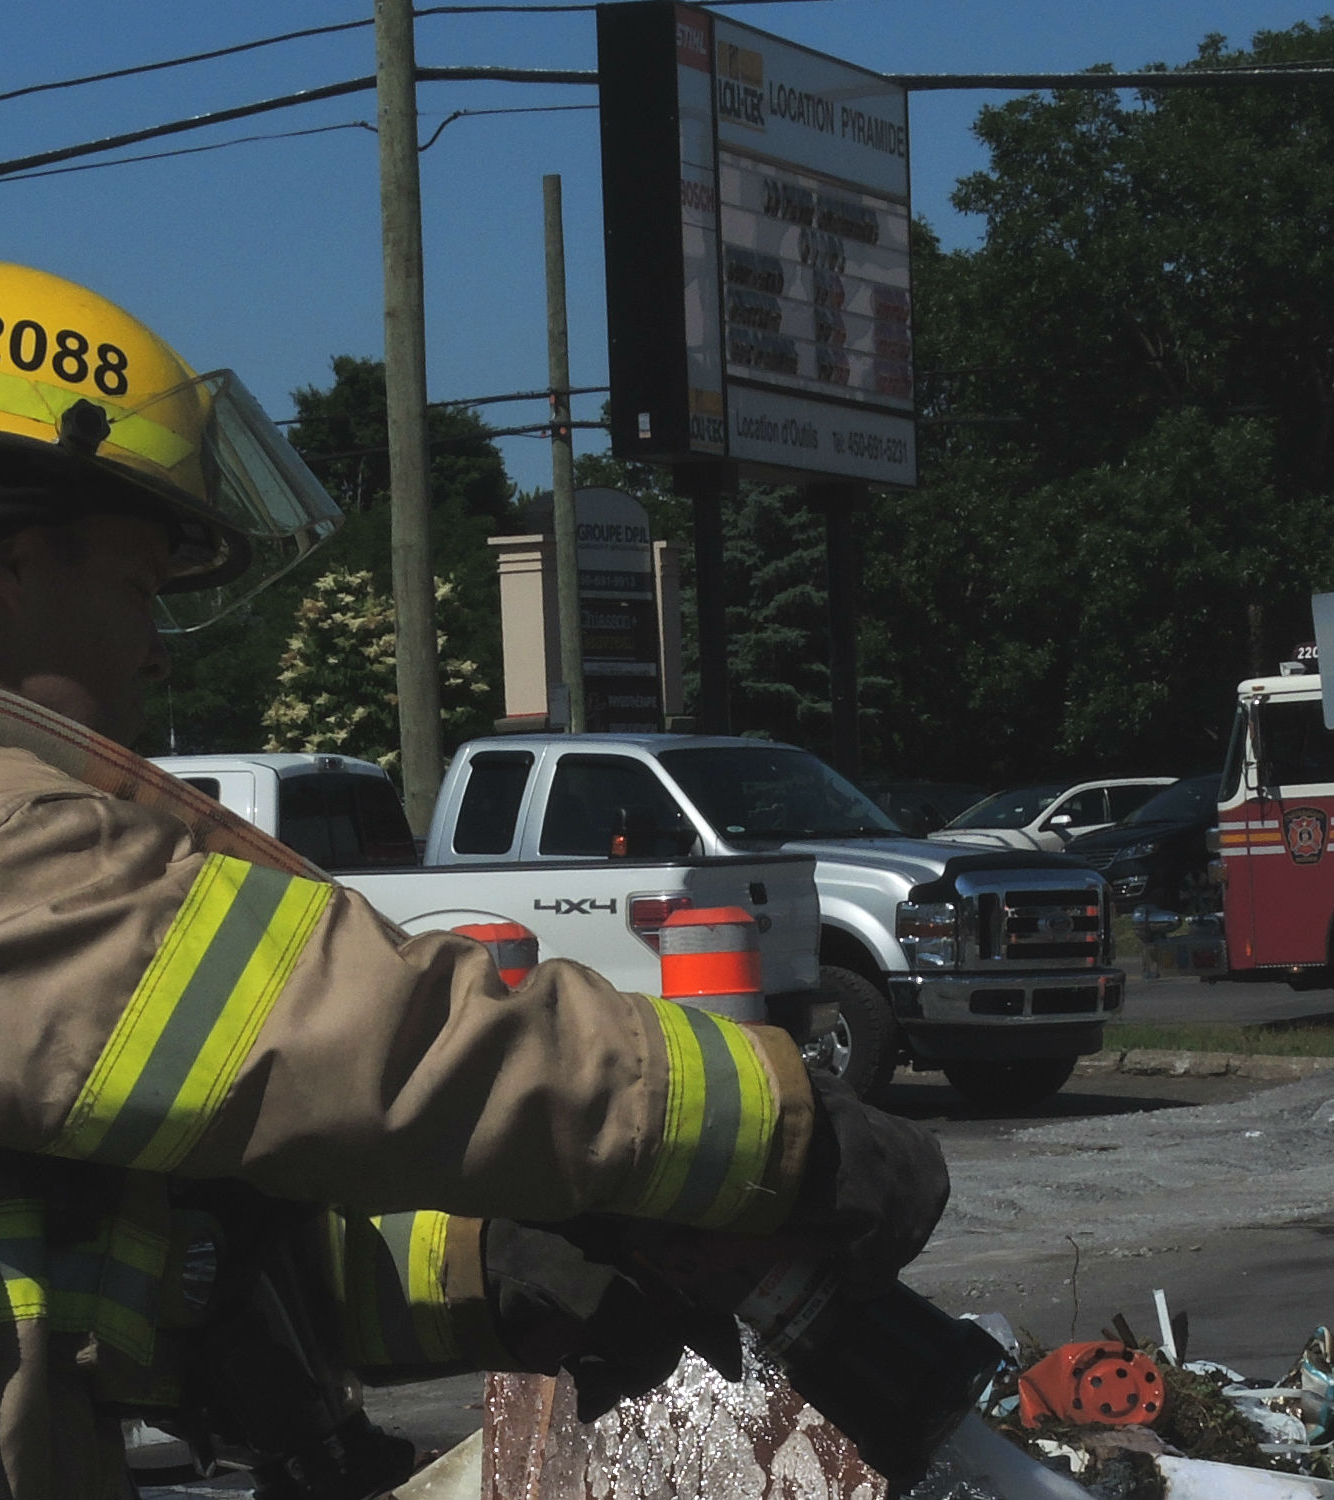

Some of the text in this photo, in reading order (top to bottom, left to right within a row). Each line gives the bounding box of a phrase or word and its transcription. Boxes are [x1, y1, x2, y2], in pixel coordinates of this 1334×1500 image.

[769, 80, 906, 157] LOCATION PYRAMIDE
[736, 408, 780, 442] Location
[782, 417, 818, 448] d'Outils
[578, 523, 650, 544] GROUPE DPJL
